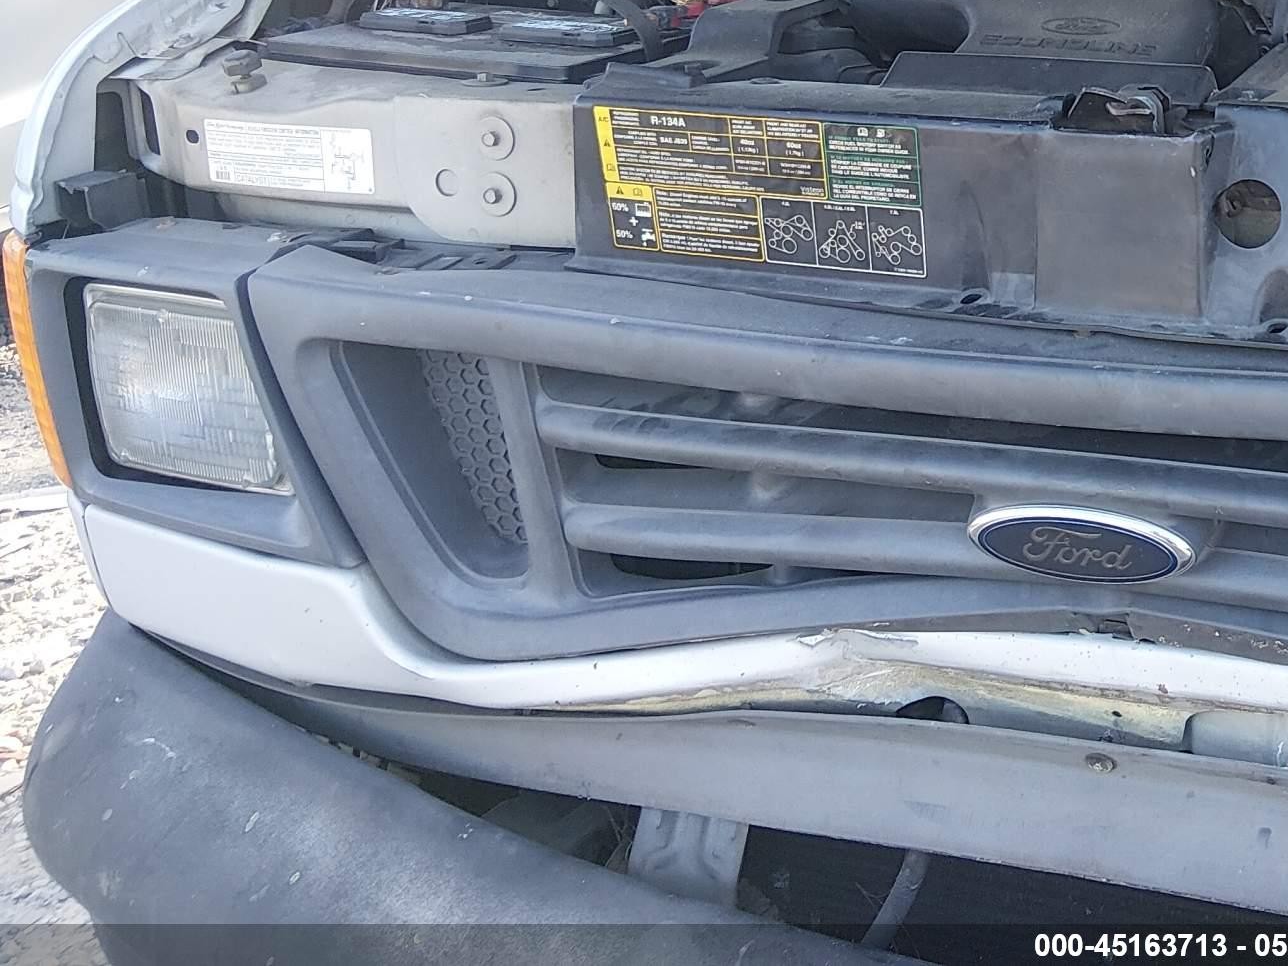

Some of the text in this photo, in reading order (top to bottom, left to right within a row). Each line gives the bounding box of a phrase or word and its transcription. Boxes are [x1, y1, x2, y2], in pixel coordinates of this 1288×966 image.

[650, 115, 686, 128] R-134A
[615, 229, 634, 239] 50%
[1022, 525, 1133, 571] Ford
